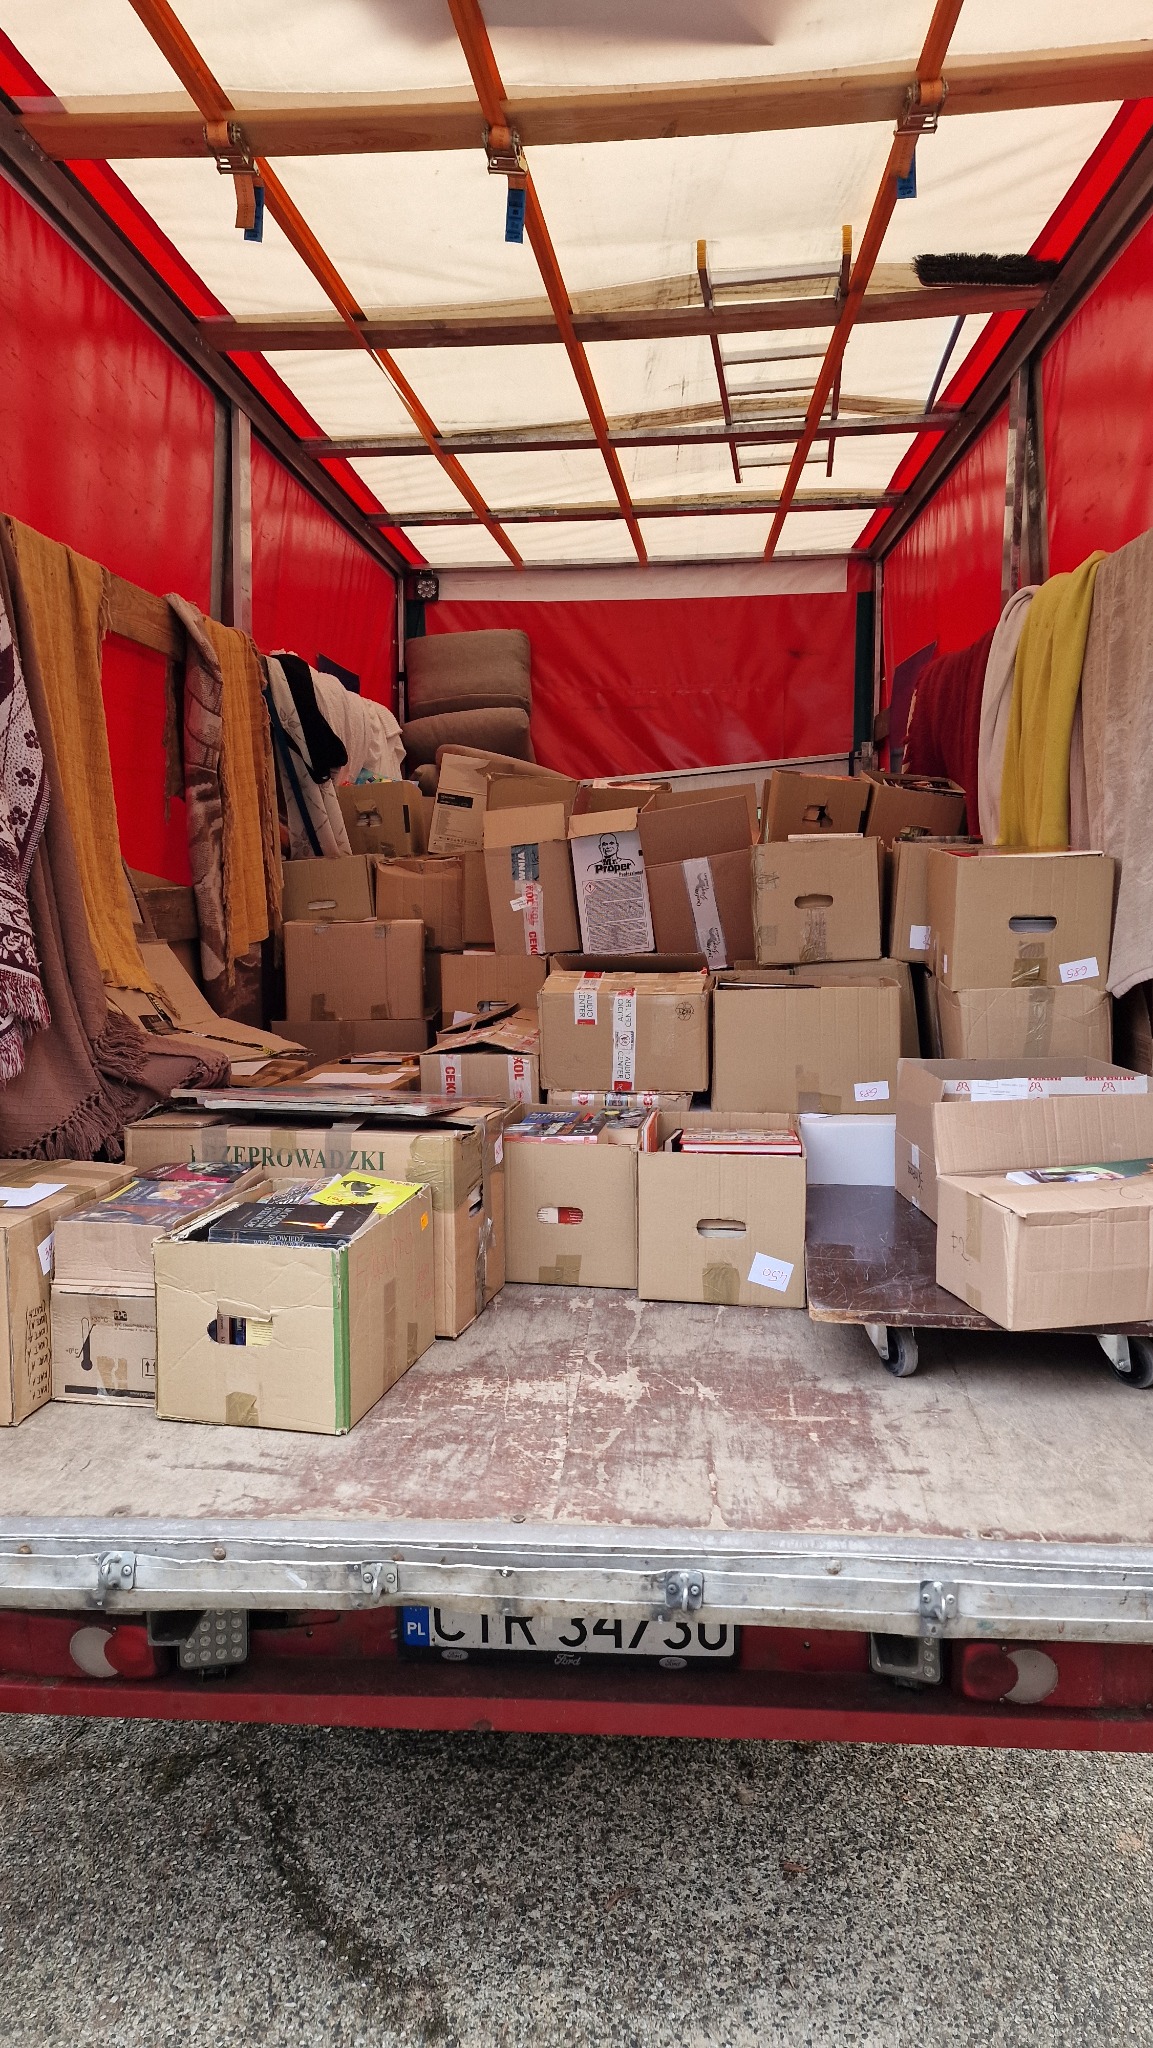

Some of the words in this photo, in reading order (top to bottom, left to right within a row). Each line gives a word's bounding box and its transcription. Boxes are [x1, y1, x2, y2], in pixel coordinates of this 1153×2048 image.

[595, 862, 632, 875] Proper
[585, 994, 594, 1018] AUDIO
[616, 1050, 624, 1079] CENTER
[624, 1056, 633, 1080] AUDIO
[190, 1145, 385, 1172] ZEPROWADZKI
[407, 1621, 426, 1636] PL
[554, 1652, 581, 1667] Ford
